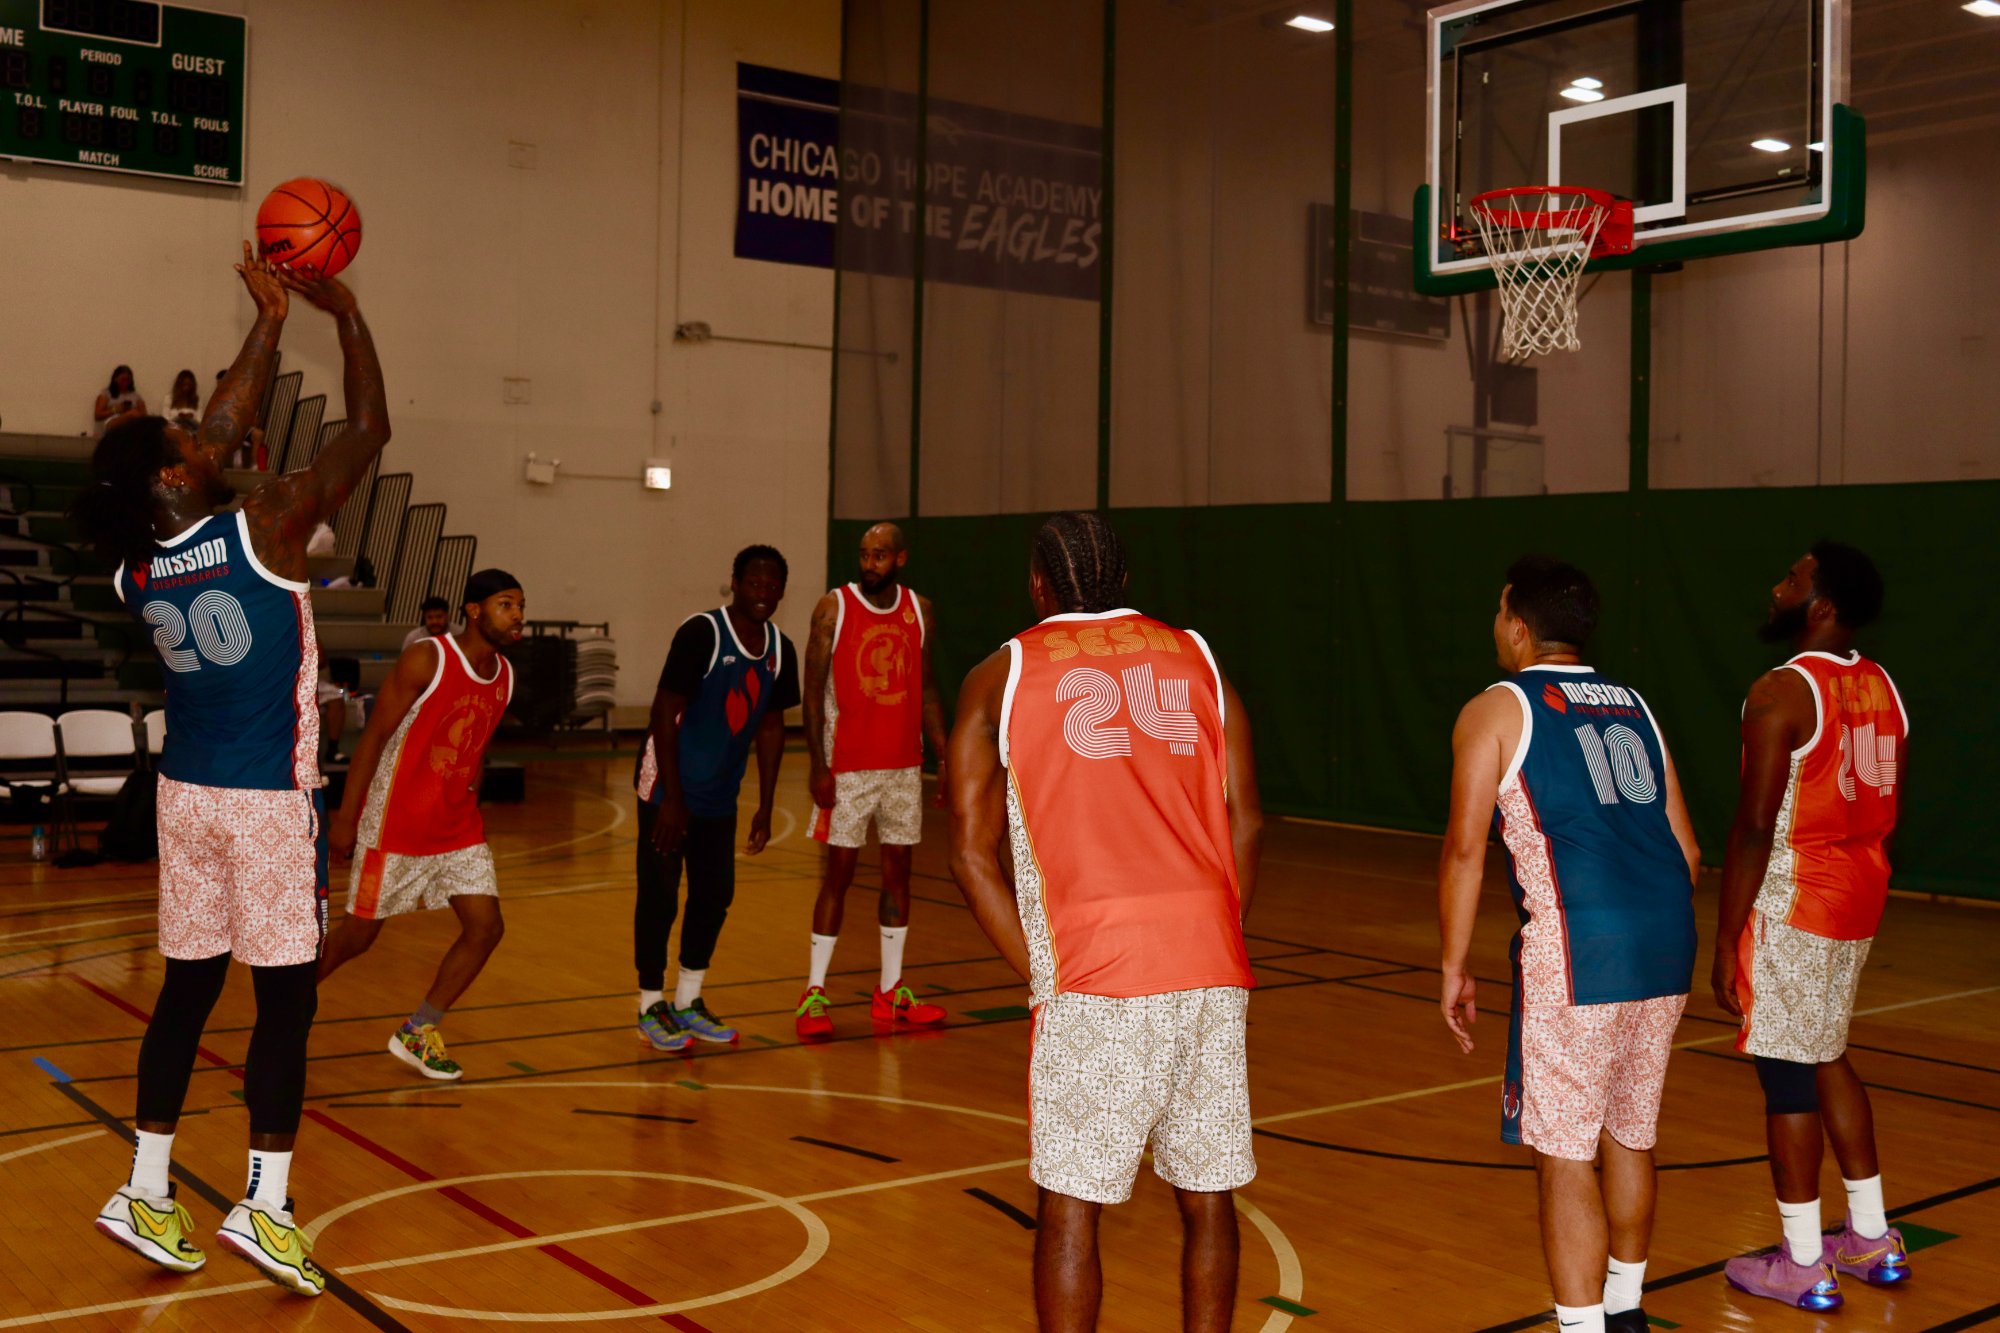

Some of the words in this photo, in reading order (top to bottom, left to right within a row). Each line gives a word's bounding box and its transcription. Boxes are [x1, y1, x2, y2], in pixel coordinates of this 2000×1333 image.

[80, 48, 122, 66] PERIOD
[172, 53, 226, 76] GUEST
[14, 92, 47, 109] T.O.L.
[59, 99, 104, 117] PLAYER
[110, 106, 140, 121] FOUL
[152, 111, 182, 127] T.O.L.
[194, 117, 230, 133] FOULS
[79, 150, 120, 166] MATCH
[194, 164, 230, 180] SCORE
[749, 132, 881, 186] CHICAGO
[976, 168, 1103, 220] ACADEMY
[747, 177, 839, 224] HOME
[850, 194, 890, 231] OF
[956, 203, 1102, 269] EAGLES
[143, 589, 252, 673] 20
[1055, 662, 1199, 760] 24
[1573, 723, 1658, 805] 10
